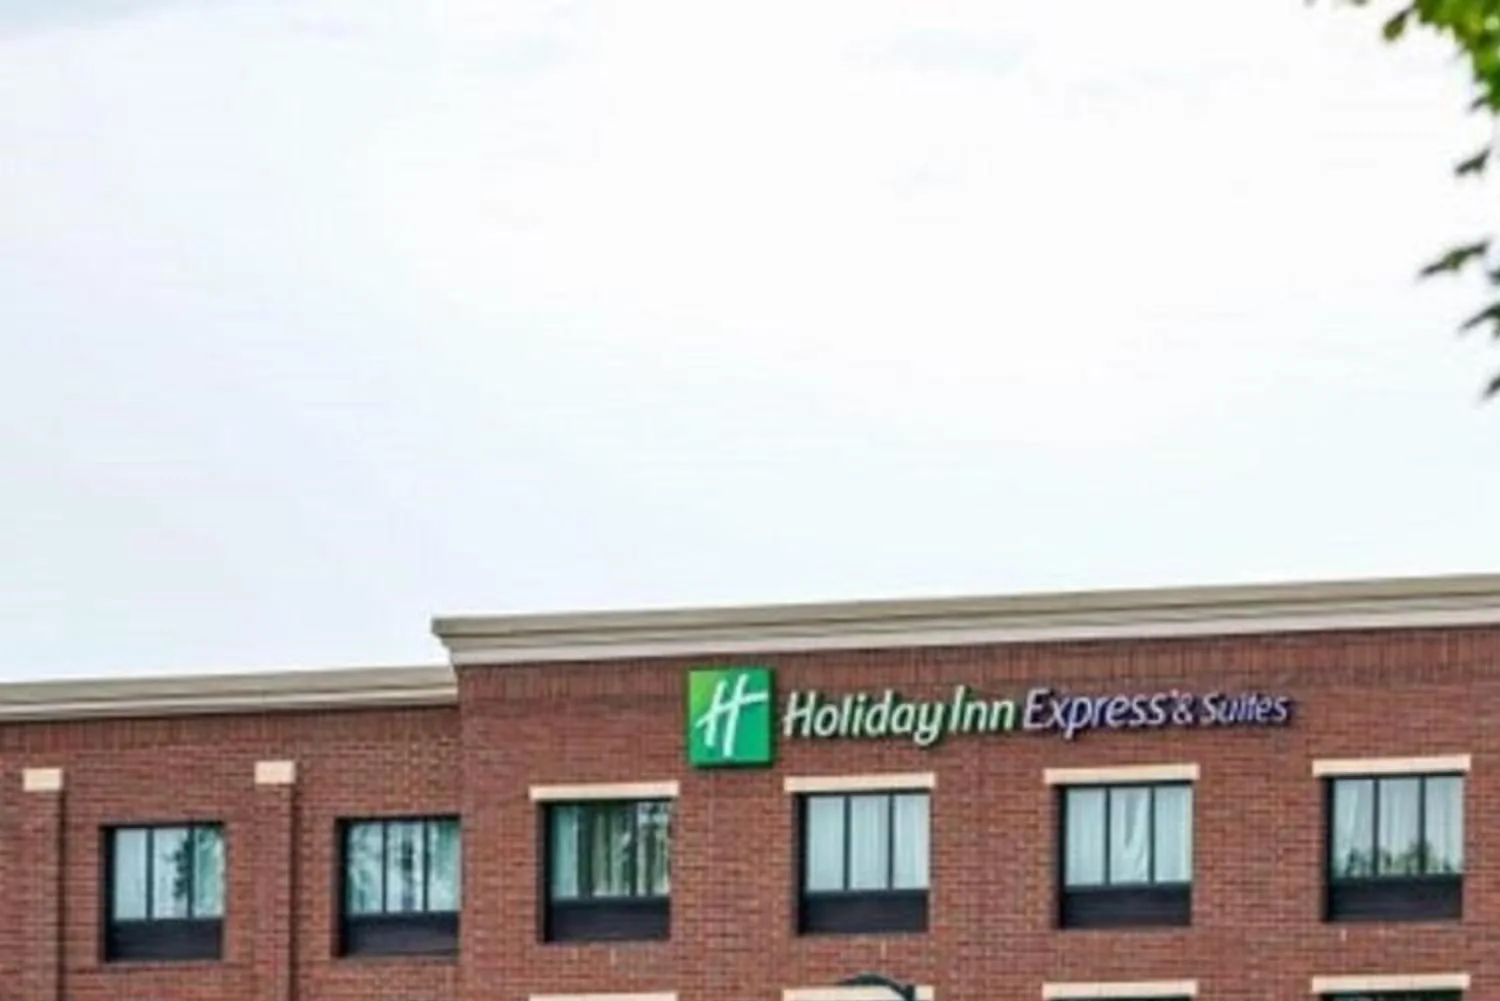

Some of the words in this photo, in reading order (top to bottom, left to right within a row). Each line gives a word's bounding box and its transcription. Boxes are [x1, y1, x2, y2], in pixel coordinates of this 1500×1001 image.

[783, 689, 945, 746] Holiday
[949, 684, 1014, 733] Inn
[1023, 687, 1167, 740] Express
[1171, 694, 1194, 725] &
[1202, 691, 1289, 726] Suites
